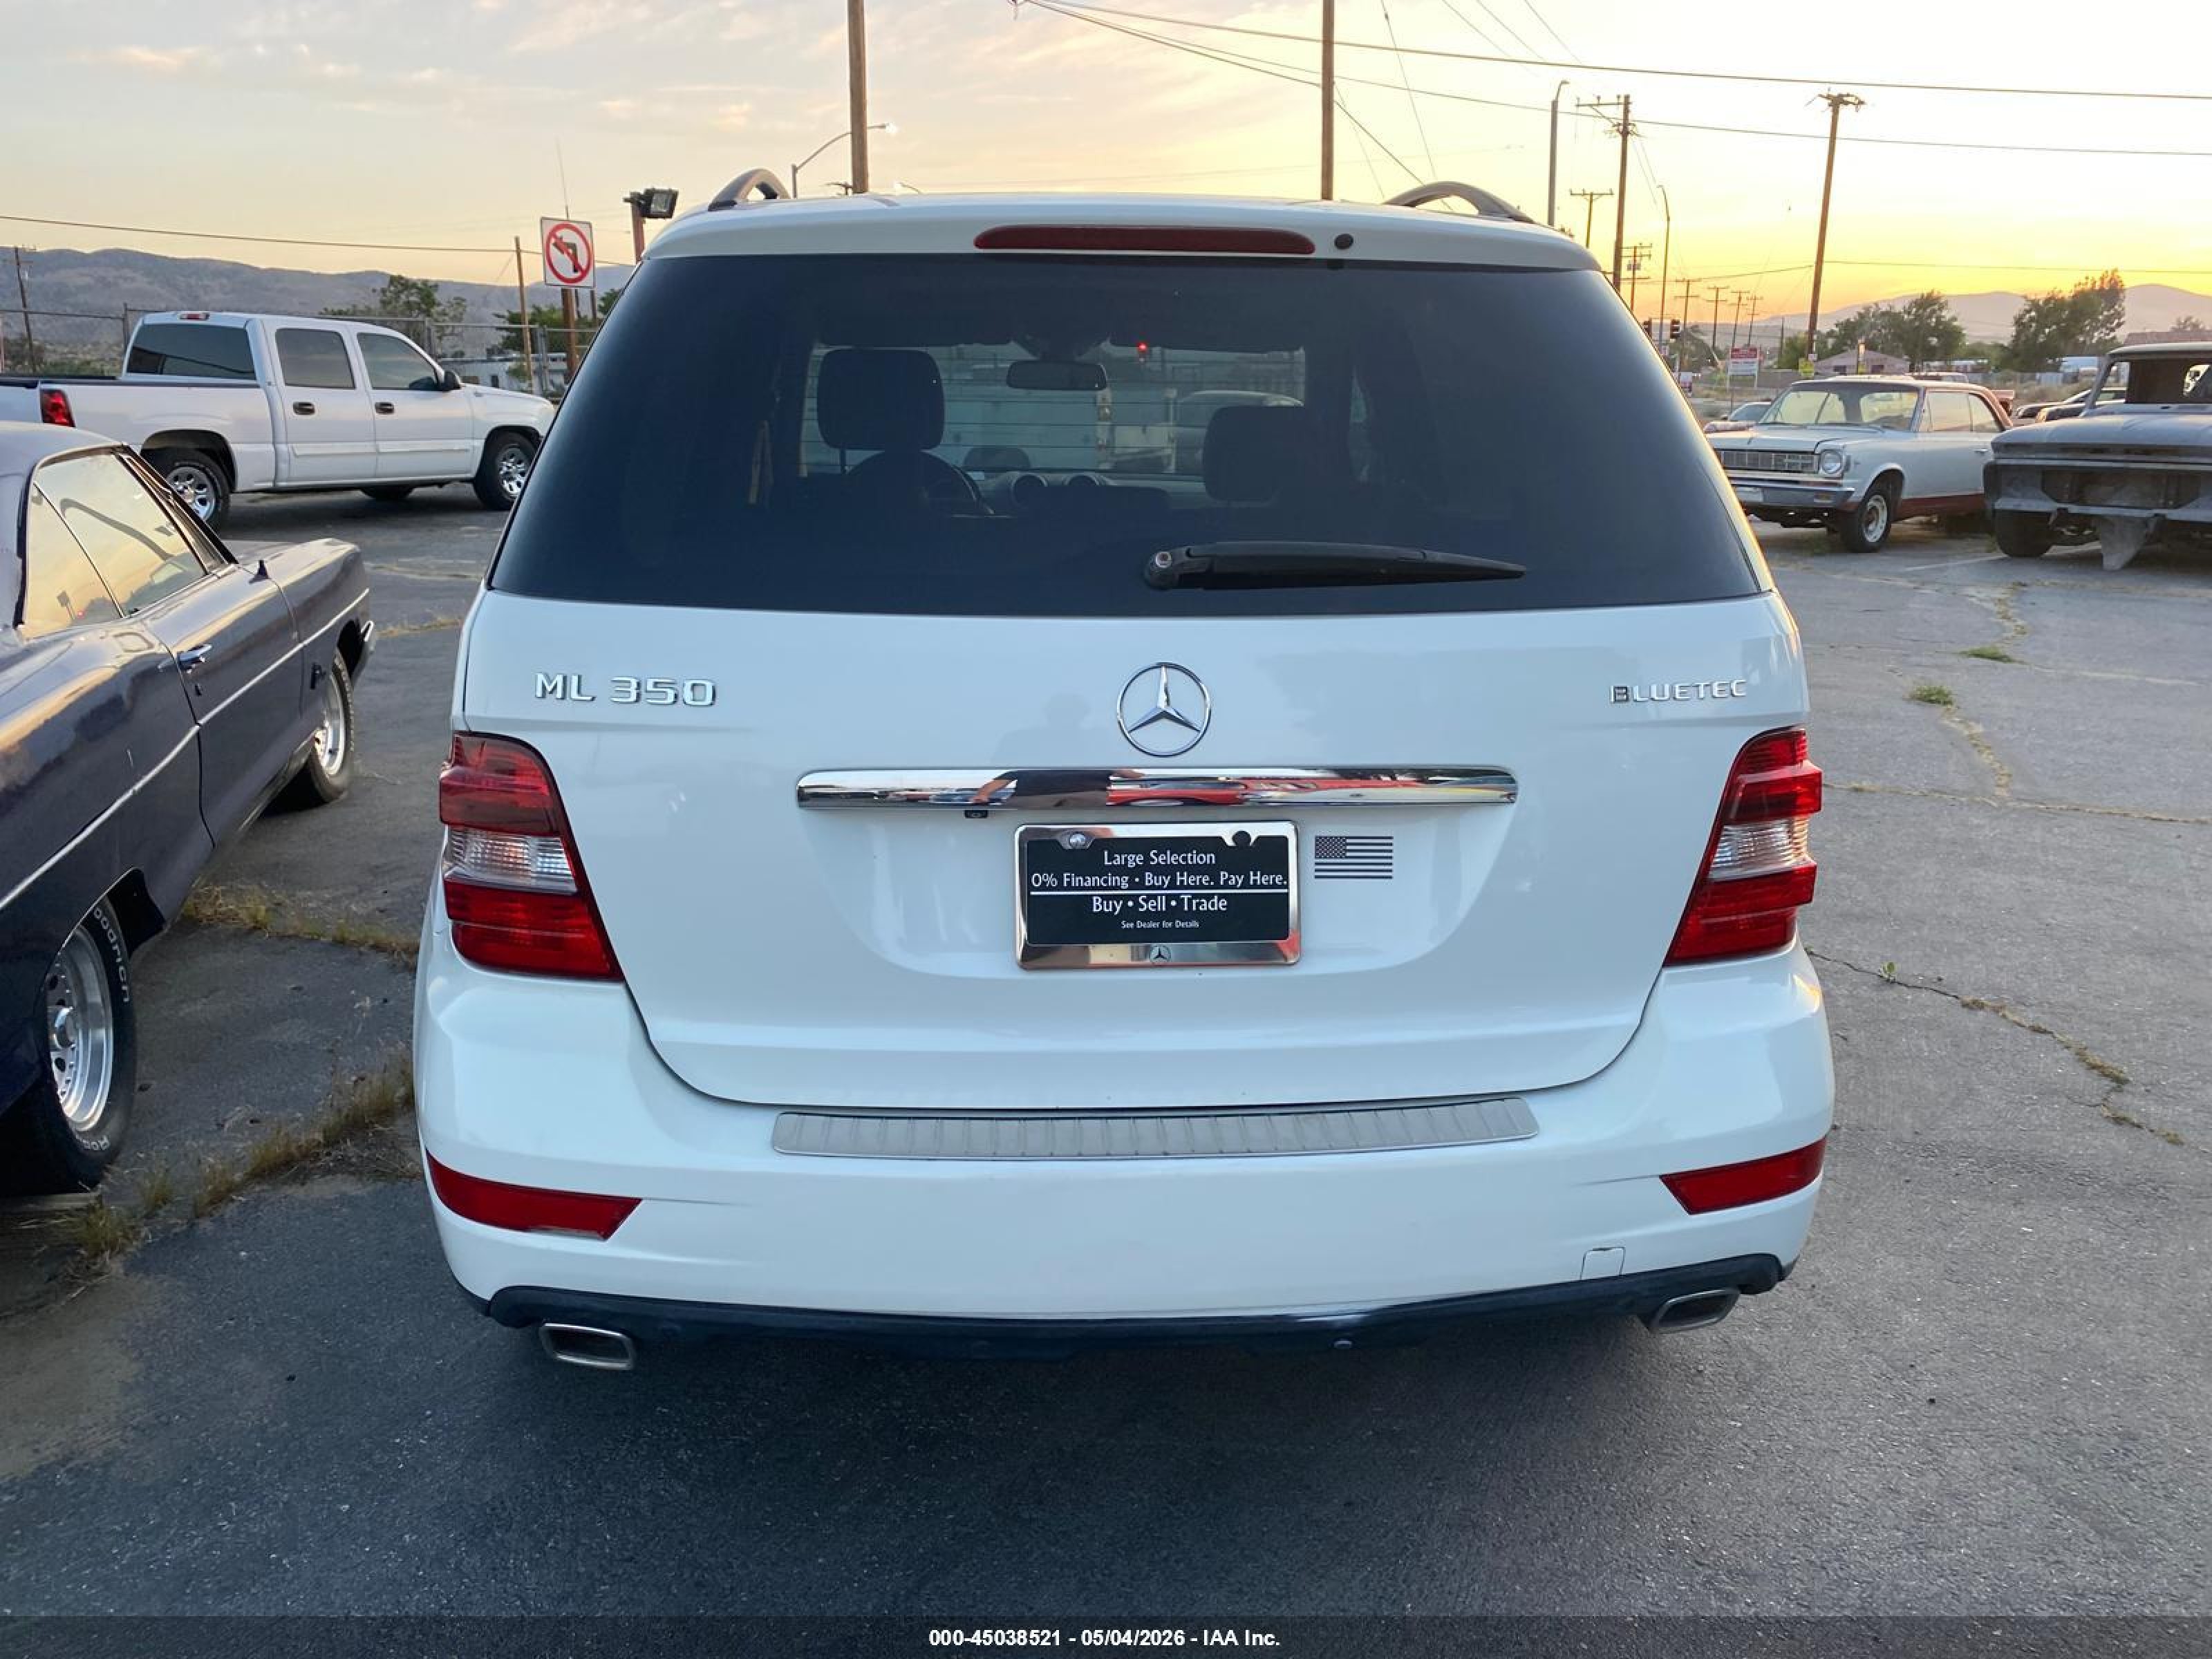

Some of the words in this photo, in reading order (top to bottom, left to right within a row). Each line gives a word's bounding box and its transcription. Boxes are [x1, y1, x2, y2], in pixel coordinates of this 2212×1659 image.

[534, 673, 596, 701] ML
[610, 677, 716, 706] 350
[1610, 679, 1746, 703] BLUETEC
[1104, 850, 1144, 868] Large
[1150, 850, 1216, 865] Selection
[1031, 873, 1058, 887] 0%
[1062, 872, 1129, 889] Financing
[1144, 872, 1172, 888] Buy
[1176, 871, 1215, 885] Here.
[1220, 871, 1245, 888] Pay
[1249, 871, 1288, 885] Here.
[1092, 895, 1123, 916] Buy
[1138, 895, 1166, 912] Sell
[1180, 895, 1228, 912] Trade
[1121, 920, 1134, 929] See
[1136, 920, 1161, 929] Dealer
[1162, 920, 1173, 928] for
[1174, 920, 1199, 928] Details
